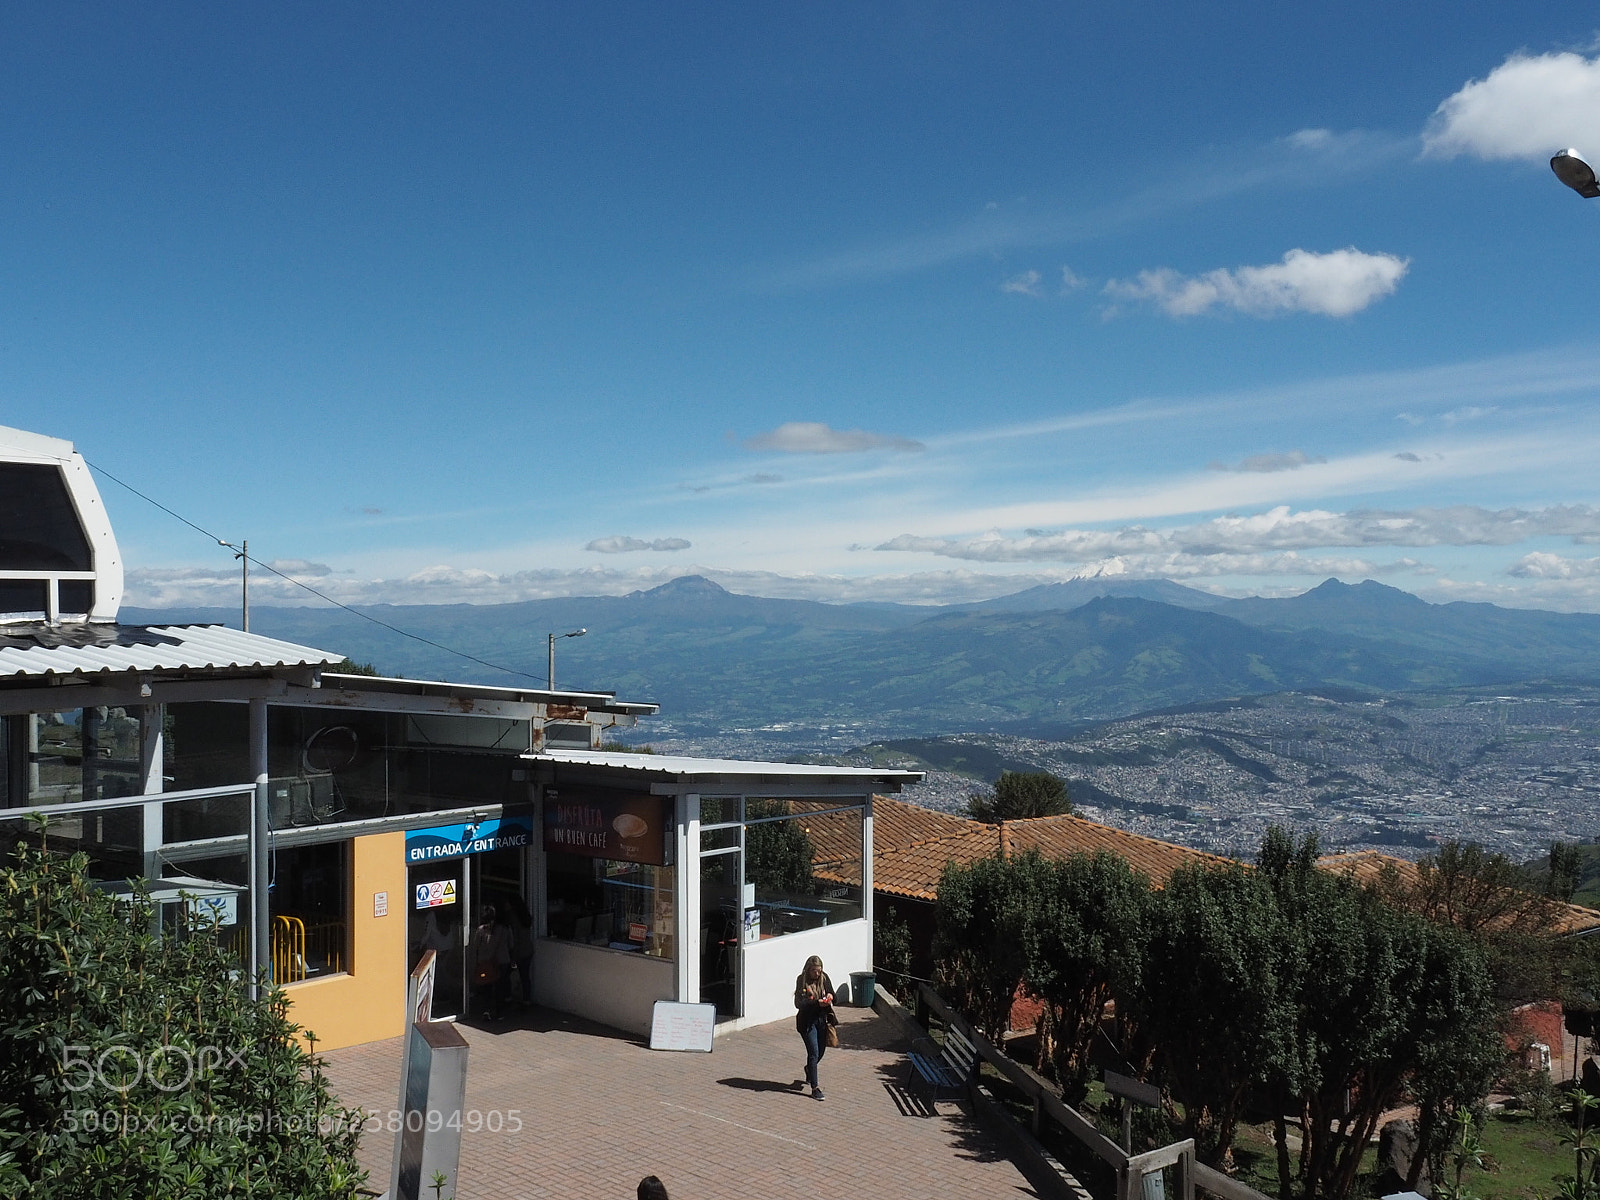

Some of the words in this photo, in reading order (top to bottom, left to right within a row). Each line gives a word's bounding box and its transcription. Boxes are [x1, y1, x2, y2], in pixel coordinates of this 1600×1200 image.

[554, 828, 564, 843] UN
[567, 829, 585, 845] BUEN
[588, 831, 607, 848] CAFÉ
